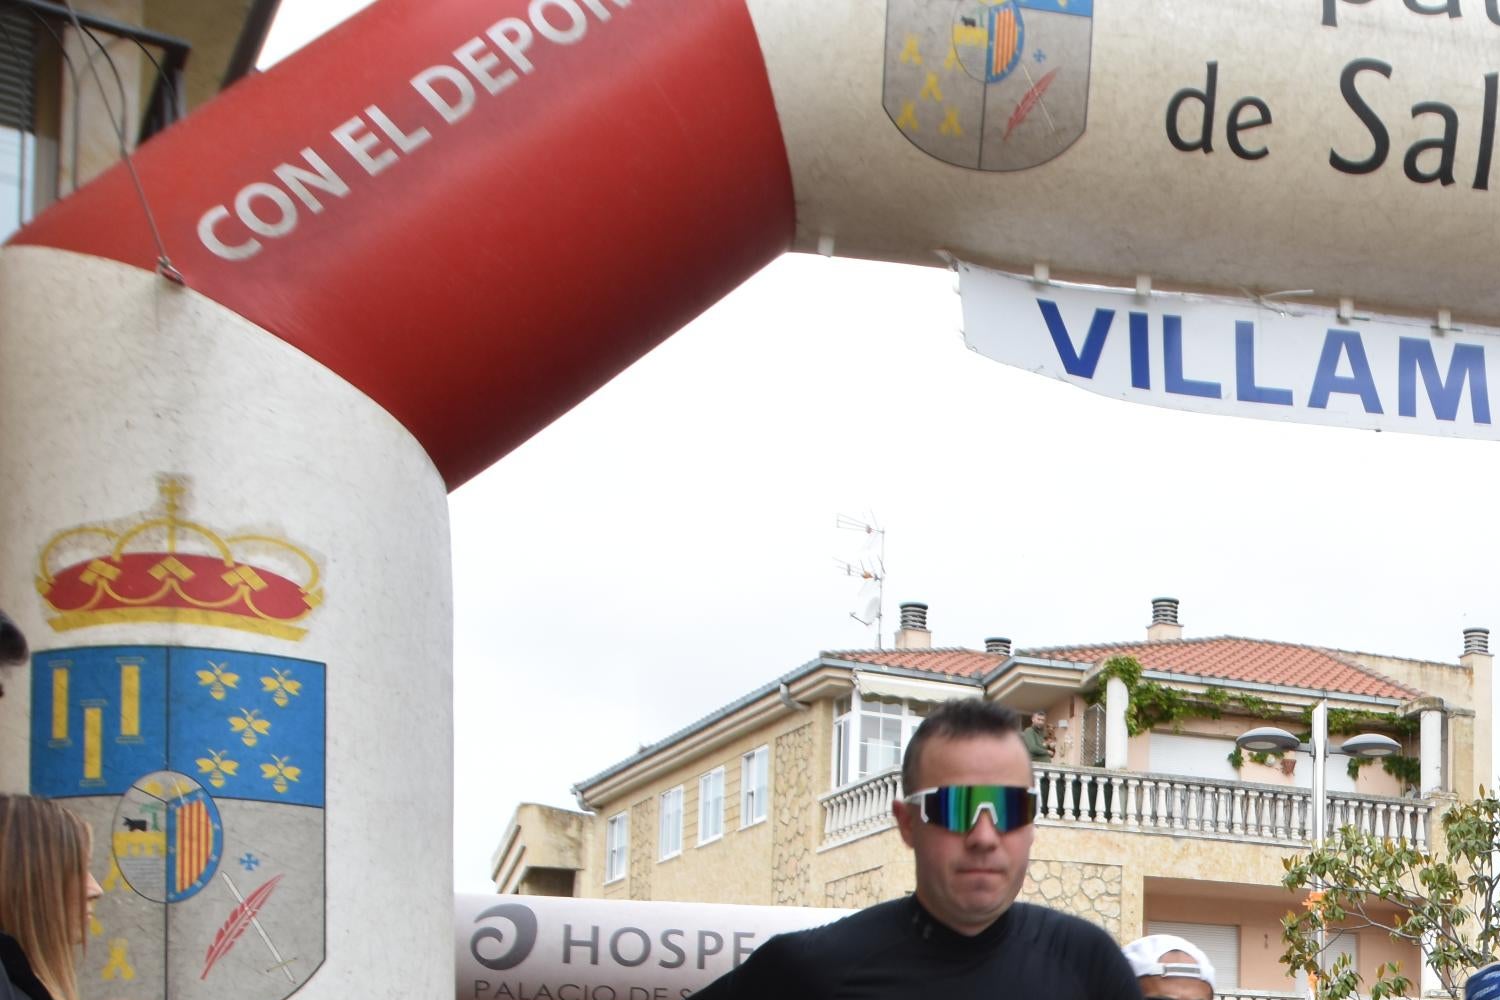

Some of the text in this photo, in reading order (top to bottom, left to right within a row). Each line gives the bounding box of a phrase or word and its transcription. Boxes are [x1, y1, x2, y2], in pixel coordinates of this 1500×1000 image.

[1165, 60, 1273, 161] de
[198, 148, 351, 261] CON
[331, 105, 433, 176] EL
